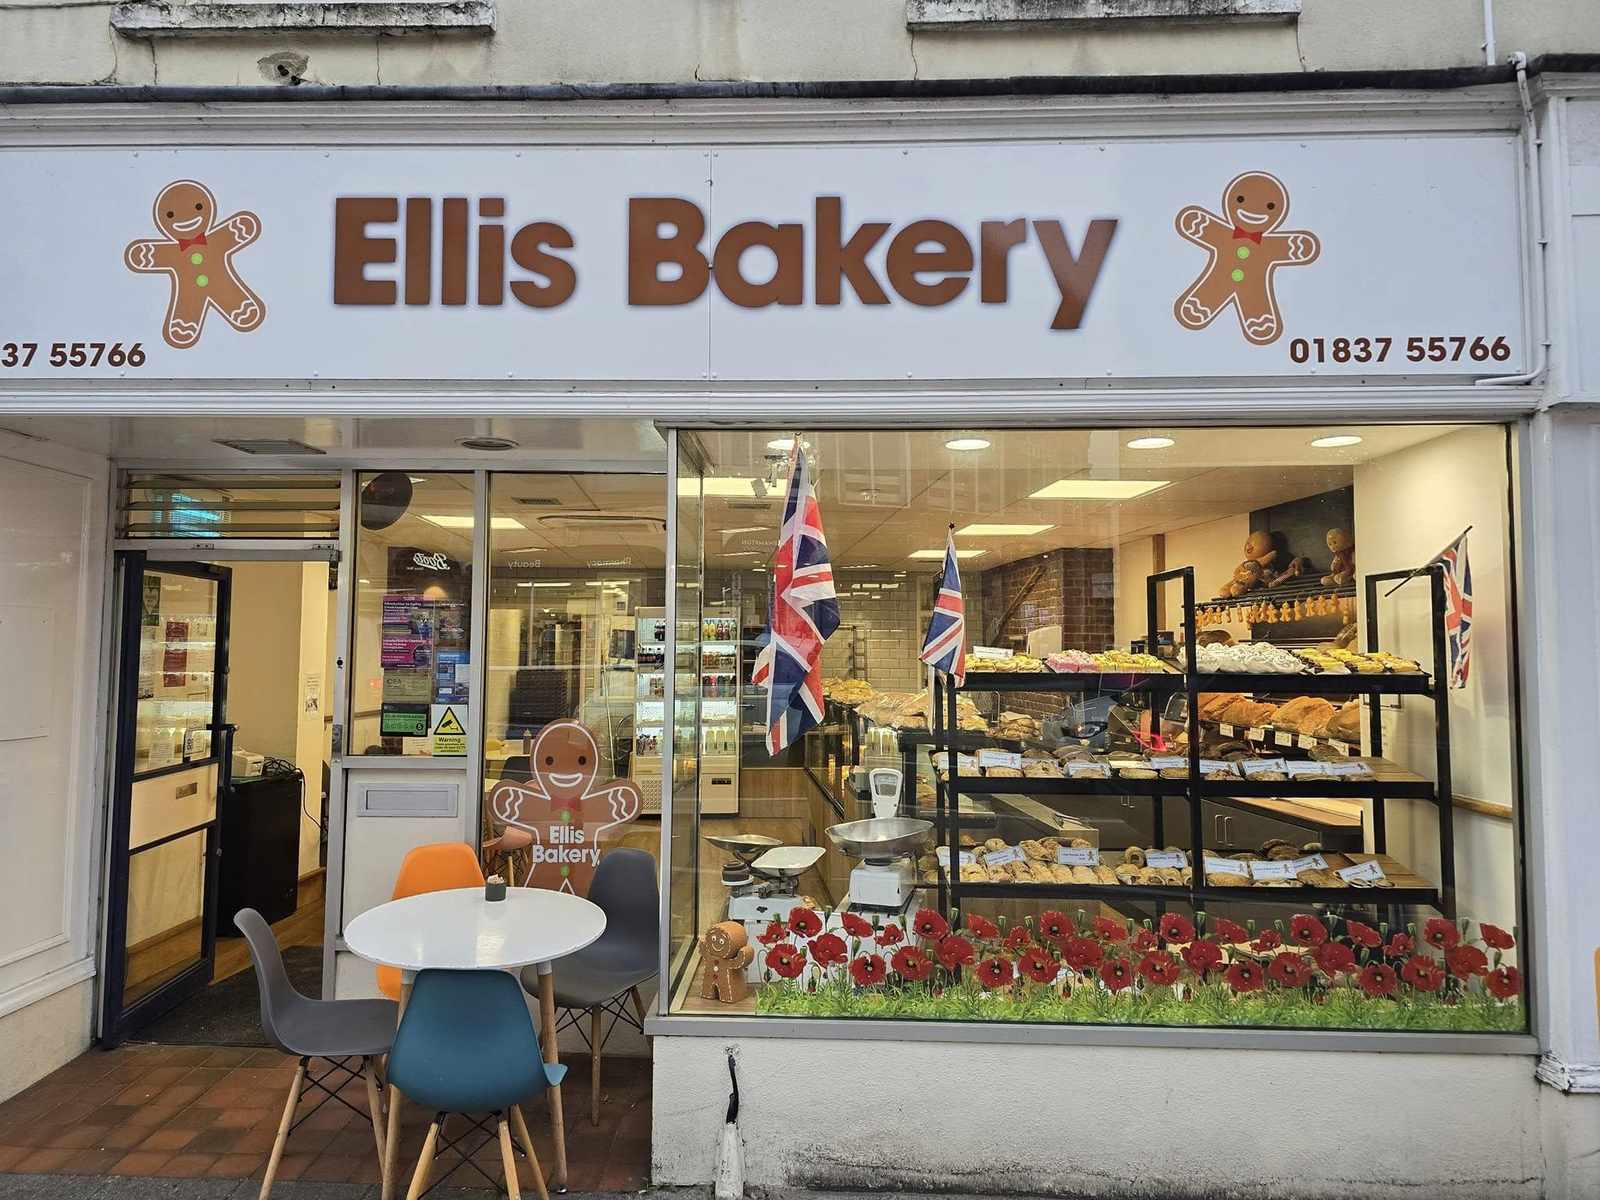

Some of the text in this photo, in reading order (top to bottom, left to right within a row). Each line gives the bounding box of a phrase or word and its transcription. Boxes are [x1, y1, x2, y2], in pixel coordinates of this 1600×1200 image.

[334, 196, 1118, 330] Ellis Bakery
[49, 343, 146, 368] 55766
[1290, 336, 1511, 364] 01837 55766
[549, 826, 585, 844] Ellis
[532, 845, 601, 867] Bakery
